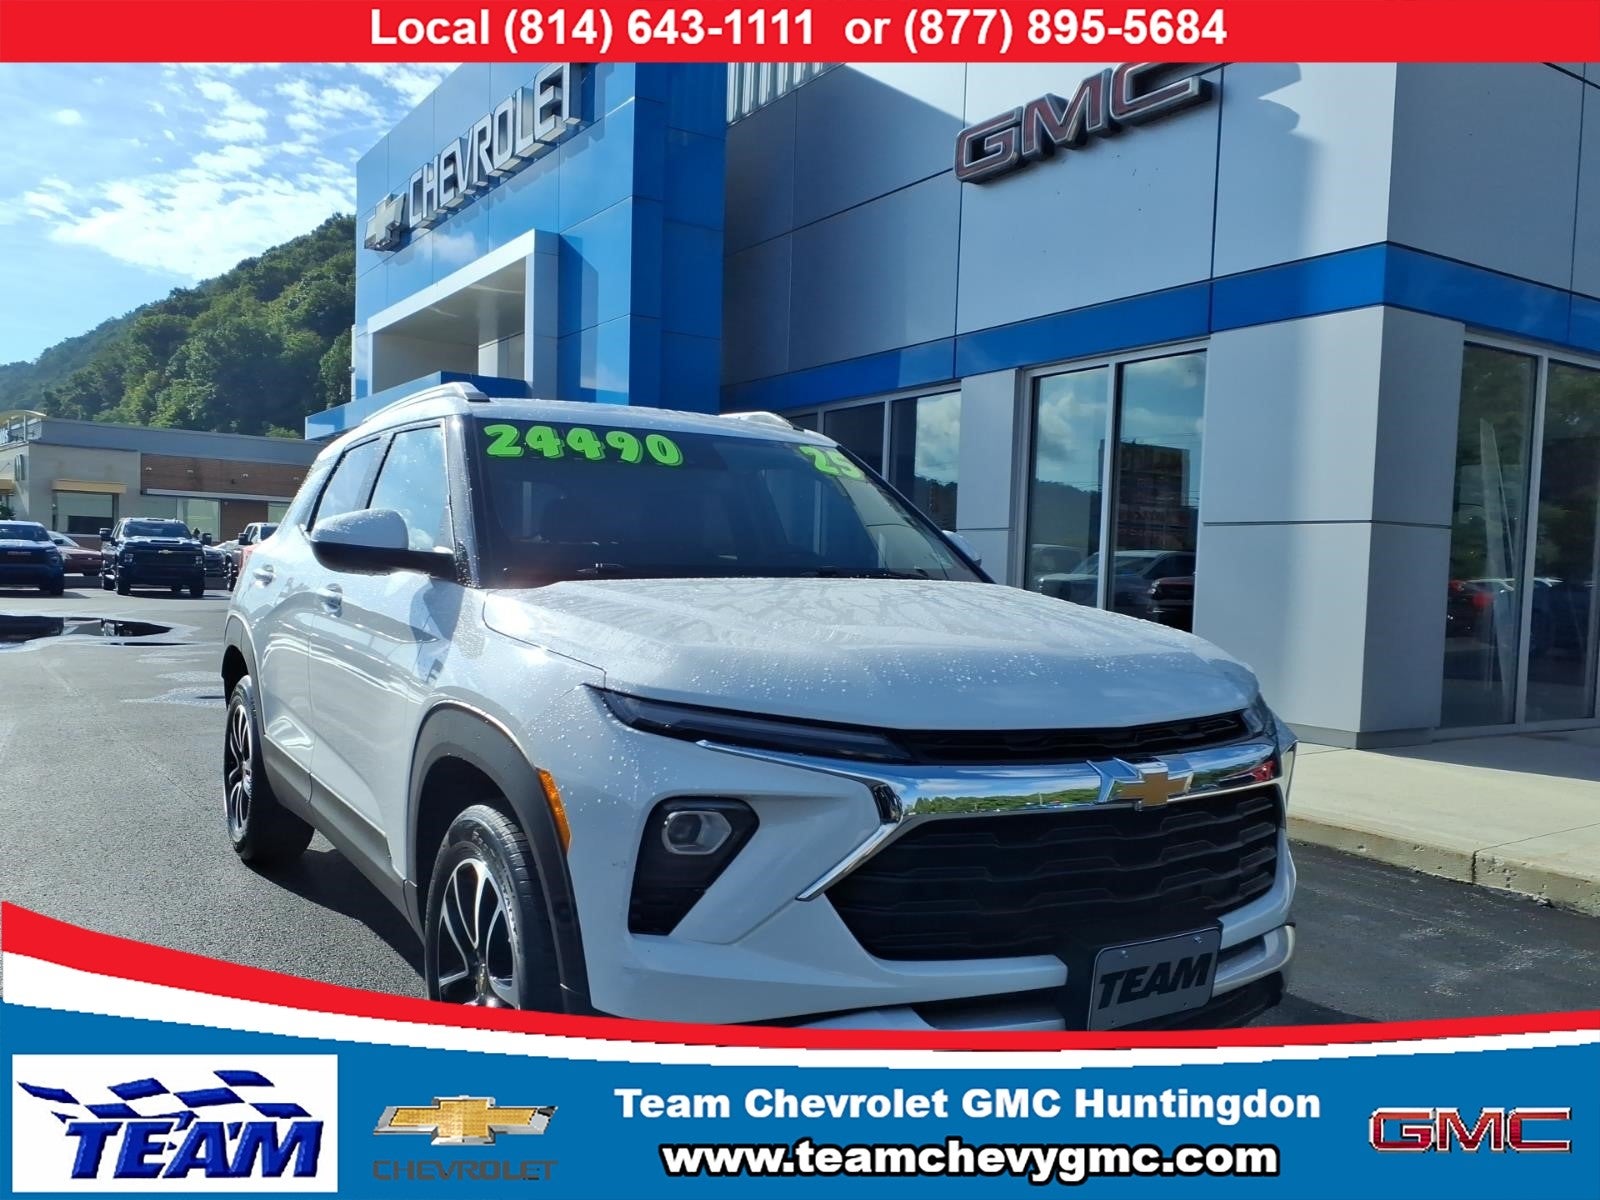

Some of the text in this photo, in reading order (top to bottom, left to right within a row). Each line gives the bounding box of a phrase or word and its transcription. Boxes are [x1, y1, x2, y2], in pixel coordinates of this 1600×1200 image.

[954, 62, 1212, 184] GMC
[483, 423, 684, 468] 24490
[798, 444, 864, 480] 25
[1098, 952, 1213, 1010] TEAM
